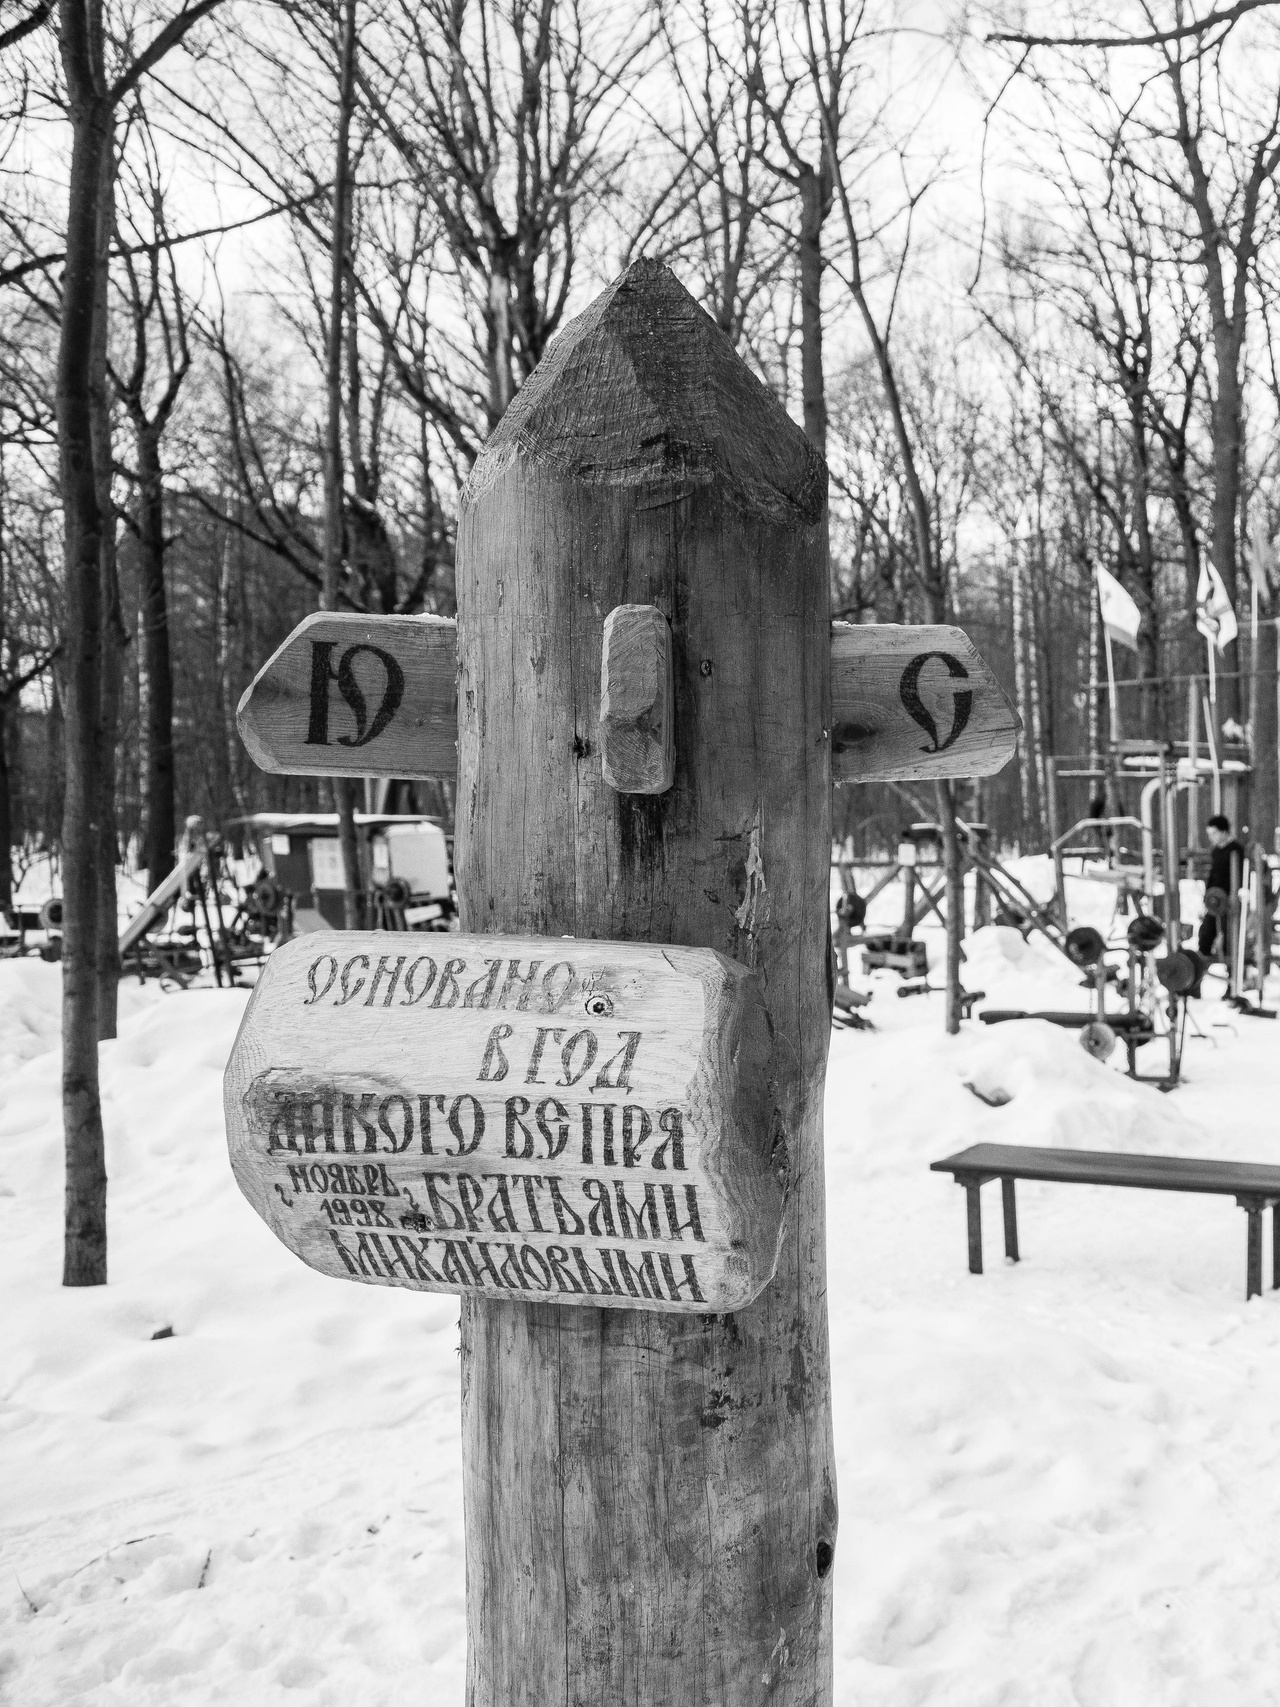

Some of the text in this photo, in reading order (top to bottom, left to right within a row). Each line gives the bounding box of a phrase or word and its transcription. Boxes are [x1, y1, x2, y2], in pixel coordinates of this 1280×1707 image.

[304, 640, 405, 747] Ю
[898, 651, 973, 754] С
[303, 954, 577, 1013] ОСНОВАНО
[476, 1023, 643, 1095] В ГОД
[266, 1091, 690, 1171] ДИКОГО ВЕПРЯ
[286, 1162, 401, 1197] НОЯБРЬ
[320, 1198, 398, 1229] 1998
[421, 1170, 706, 1243] БРАТЬЯМИ
[327, 1228, 710, 1304] МИХАЙЛОВЫМИ
